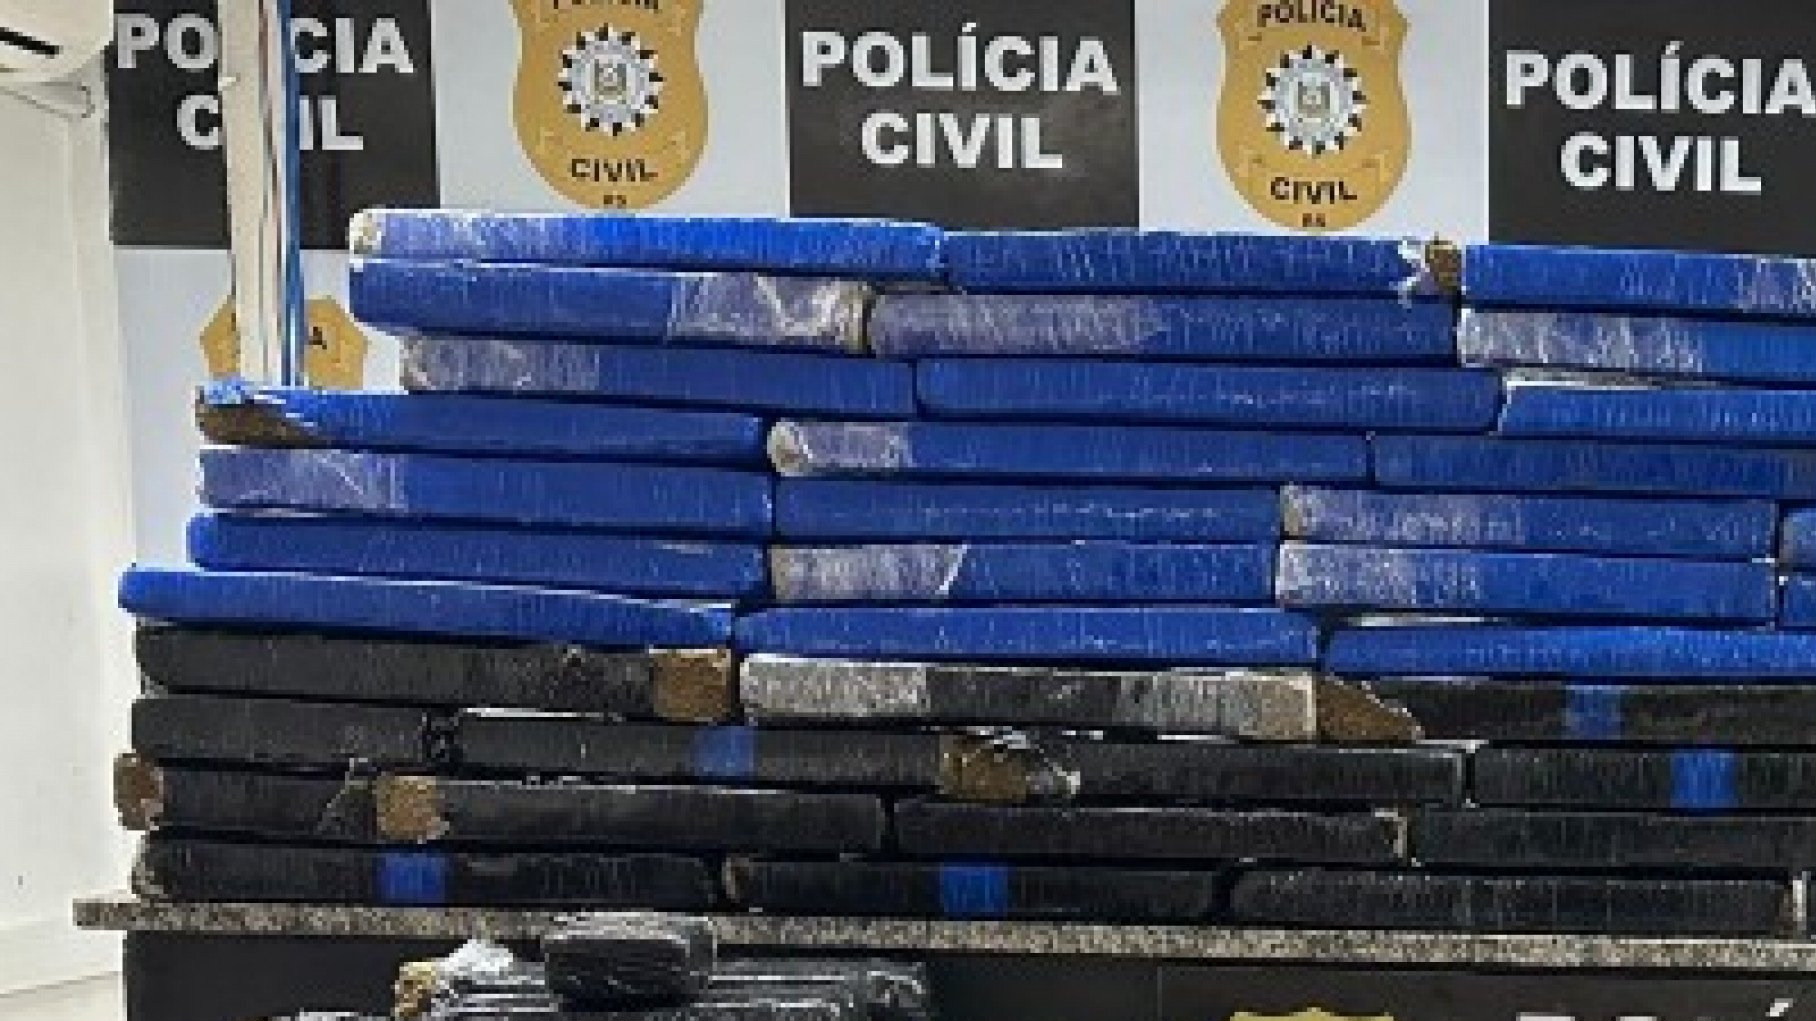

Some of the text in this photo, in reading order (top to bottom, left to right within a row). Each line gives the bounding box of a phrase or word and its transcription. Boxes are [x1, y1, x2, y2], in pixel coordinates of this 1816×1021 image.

[117, 14, 413, 73] POCIA
[800, 22, 1120, 94] POLÍCIA
[177, 95, 364, 150] CIL
[862, 112, 1063, 168] CIVIL
[571, 158, 659, 182] CIVIL
[1270, 177, 1358, 204] CIVIL
[1560, 132, 1762, 195] CIVIL
